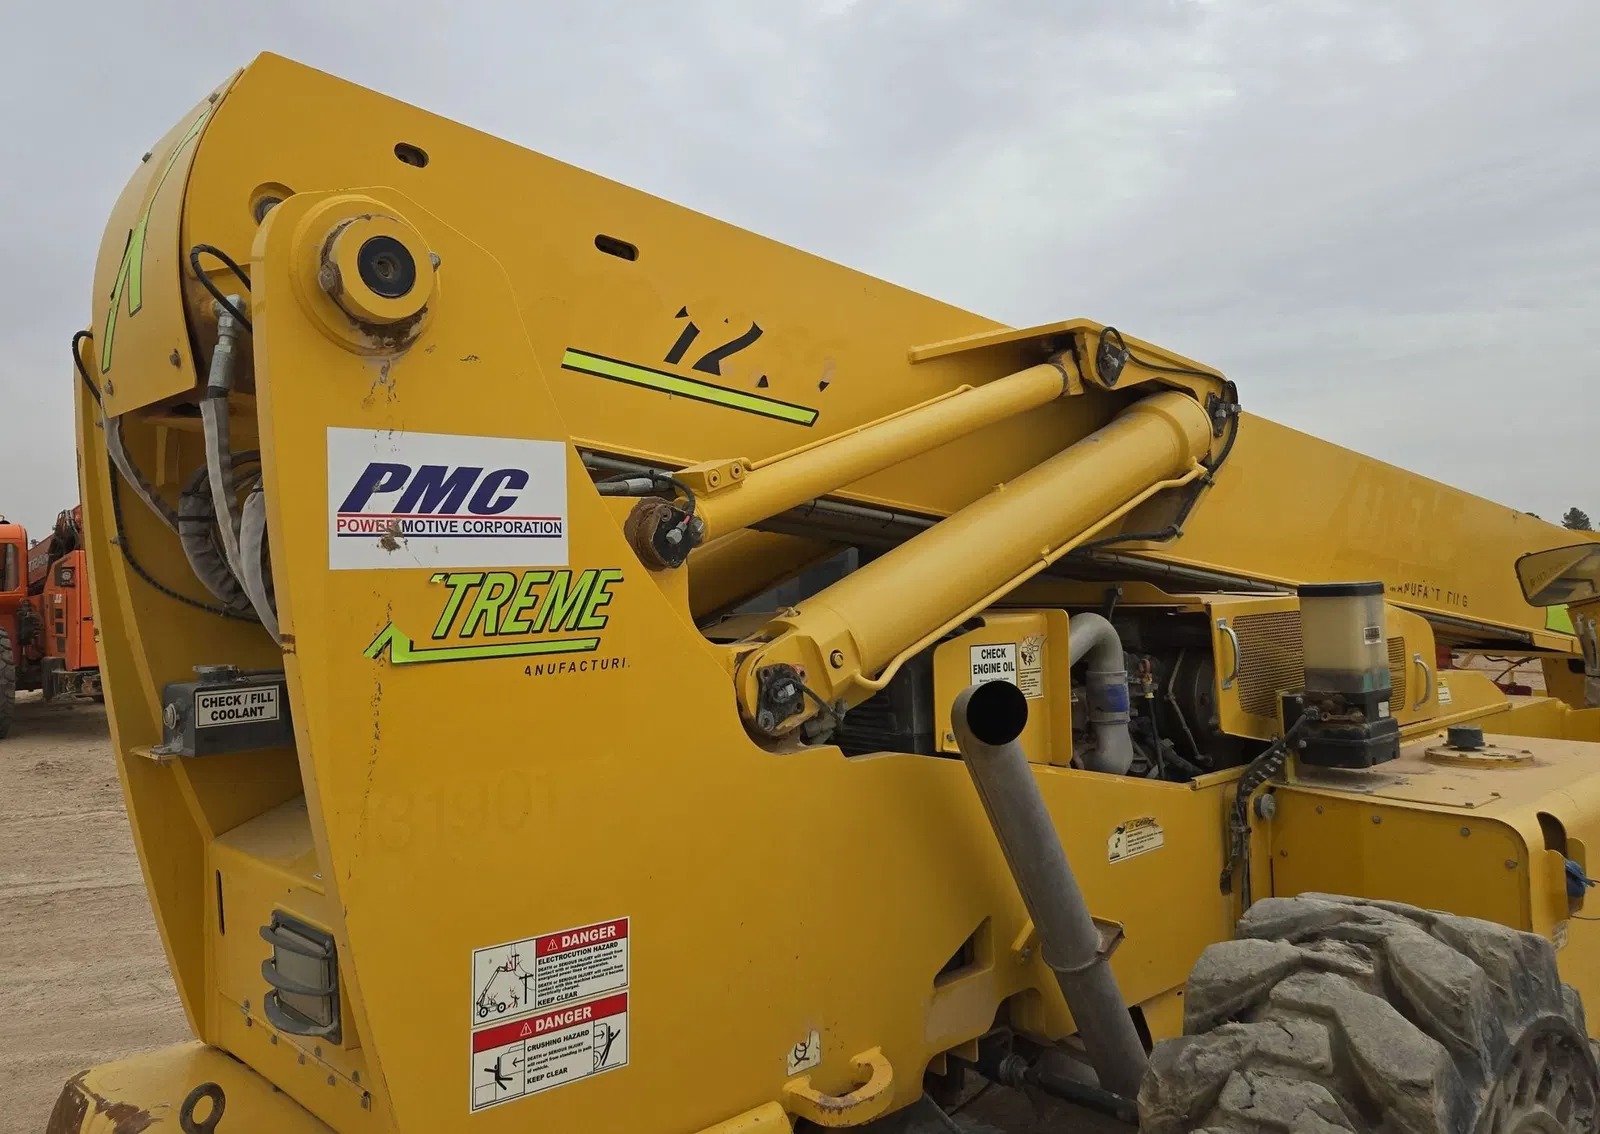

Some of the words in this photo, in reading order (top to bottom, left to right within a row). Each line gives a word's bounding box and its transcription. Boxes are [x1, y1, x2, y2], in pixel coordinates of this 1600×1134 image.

[338, 462, 529, 515] PMC
[402, 520, 458, 533] MOTIVE
[463, 520, 562, 534] CORPORATION
[429, 568, 625, 640] TREME
[981, 648, 1006, 659] CHECK
[973, 663, 1001, 674] ENGINE
[1003, 662, 1014, 672] OIL
[202, 695, 242, 708] CHECK
[244, 694, 248, 704] /
[251, 693, 274, 703] FILL
[211, 706, 265, 721] COOLANT
[562, 925, 616, 948] DANGER
[538, 949, 592, 965] ELECTROCUTION
[593, 942, 618, 952] HAZARD
[559, 975, 577, 983] SERIOUS
[538, 997, 555, 1006] KEEP
[557, 991, 577, 1001] CLEAR
[535, 1006, 592, 1032] DANGER
[527, 1037, 561, 1052] CRUSHING
[564, 1030, 589, 1042] HAZARD
[549, 1046, 567, 1055] SERIOUS
[527, 1075, 544, 1084] KEEP
[546, 1067, 568, 1078] CLEAR
